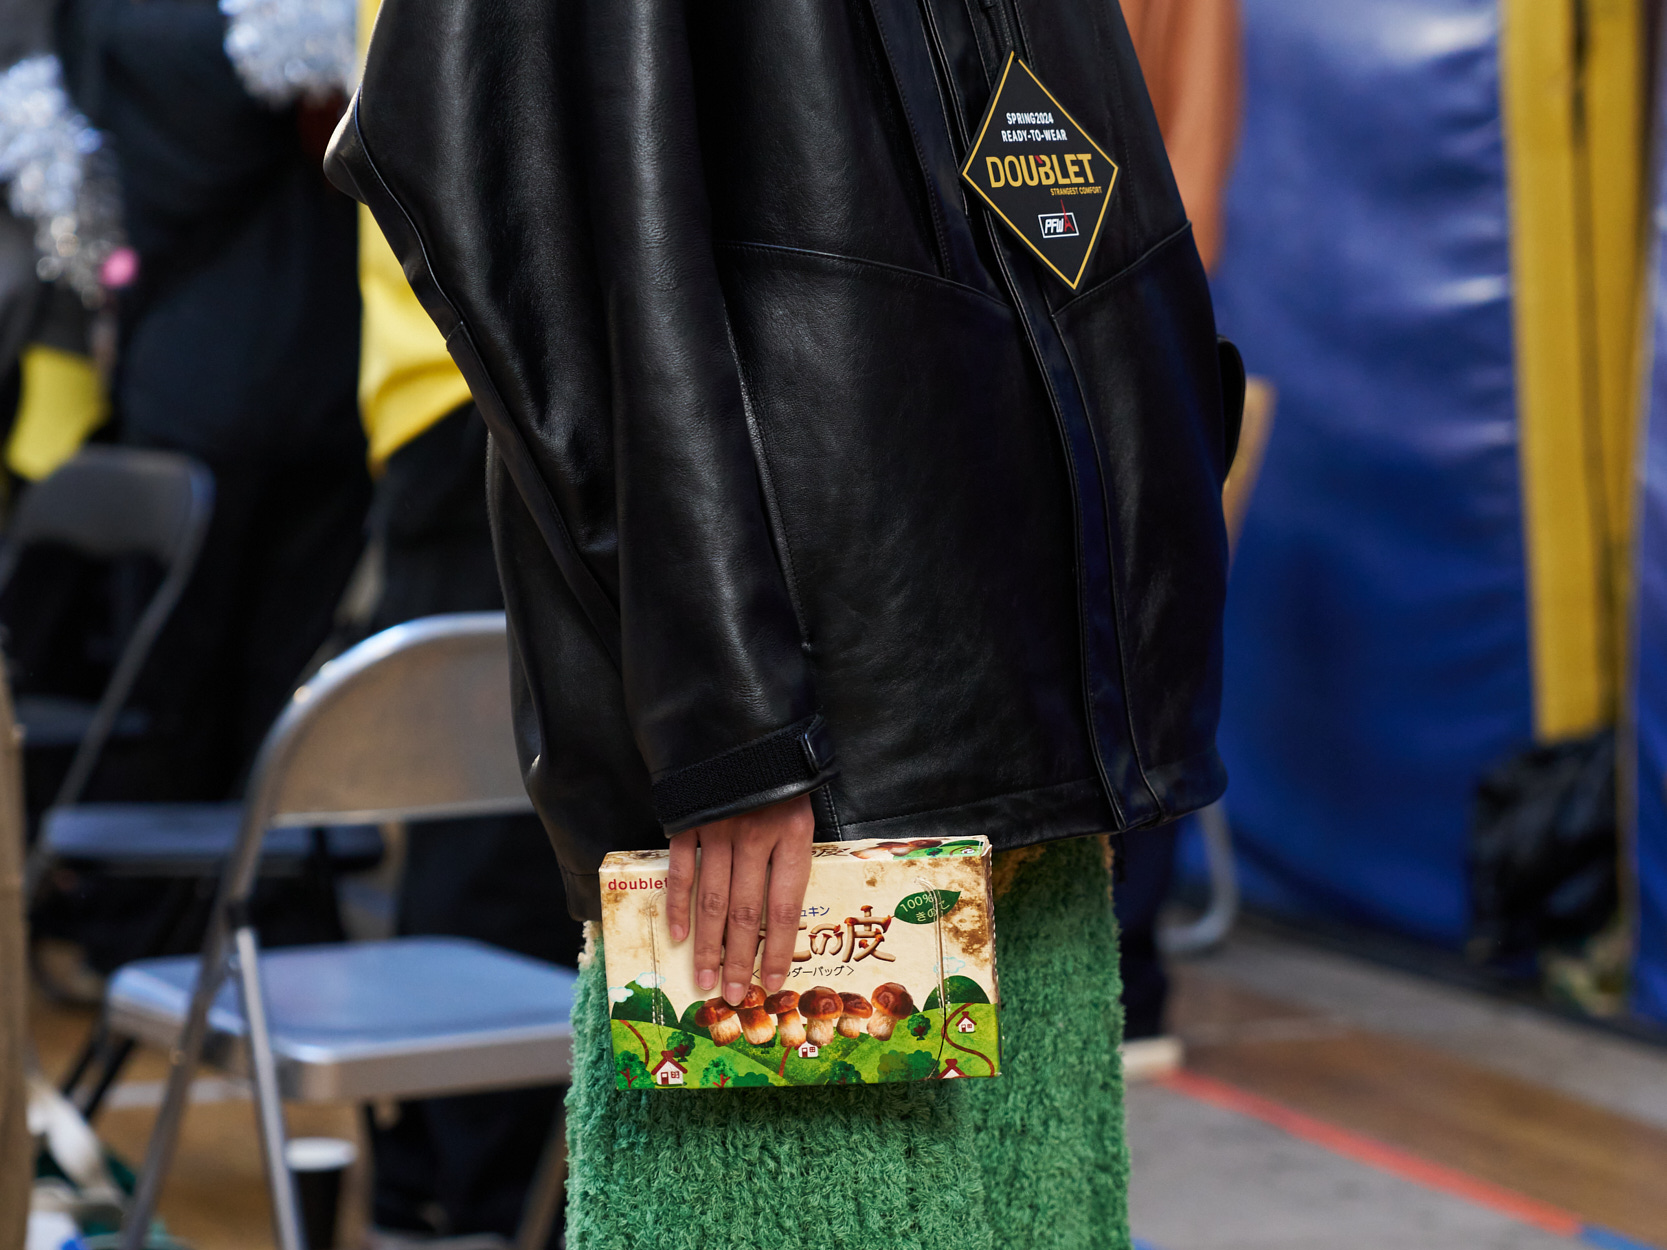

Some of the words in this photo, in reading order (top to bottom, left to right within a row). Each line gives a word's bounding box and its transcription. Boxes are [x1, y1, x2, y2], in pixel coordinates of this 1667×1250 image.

[1001, 128, 1067, 142] READY-TO-WEAR
[985, 153, 1095, 188] DOUBLET
[1050, 186, 1079, 196] STRANGEST
[1079, 185, 1102, 195] COMFORT
[900, 893, 934, 912] 100%
[915, 900, 950, 922] きのこ
